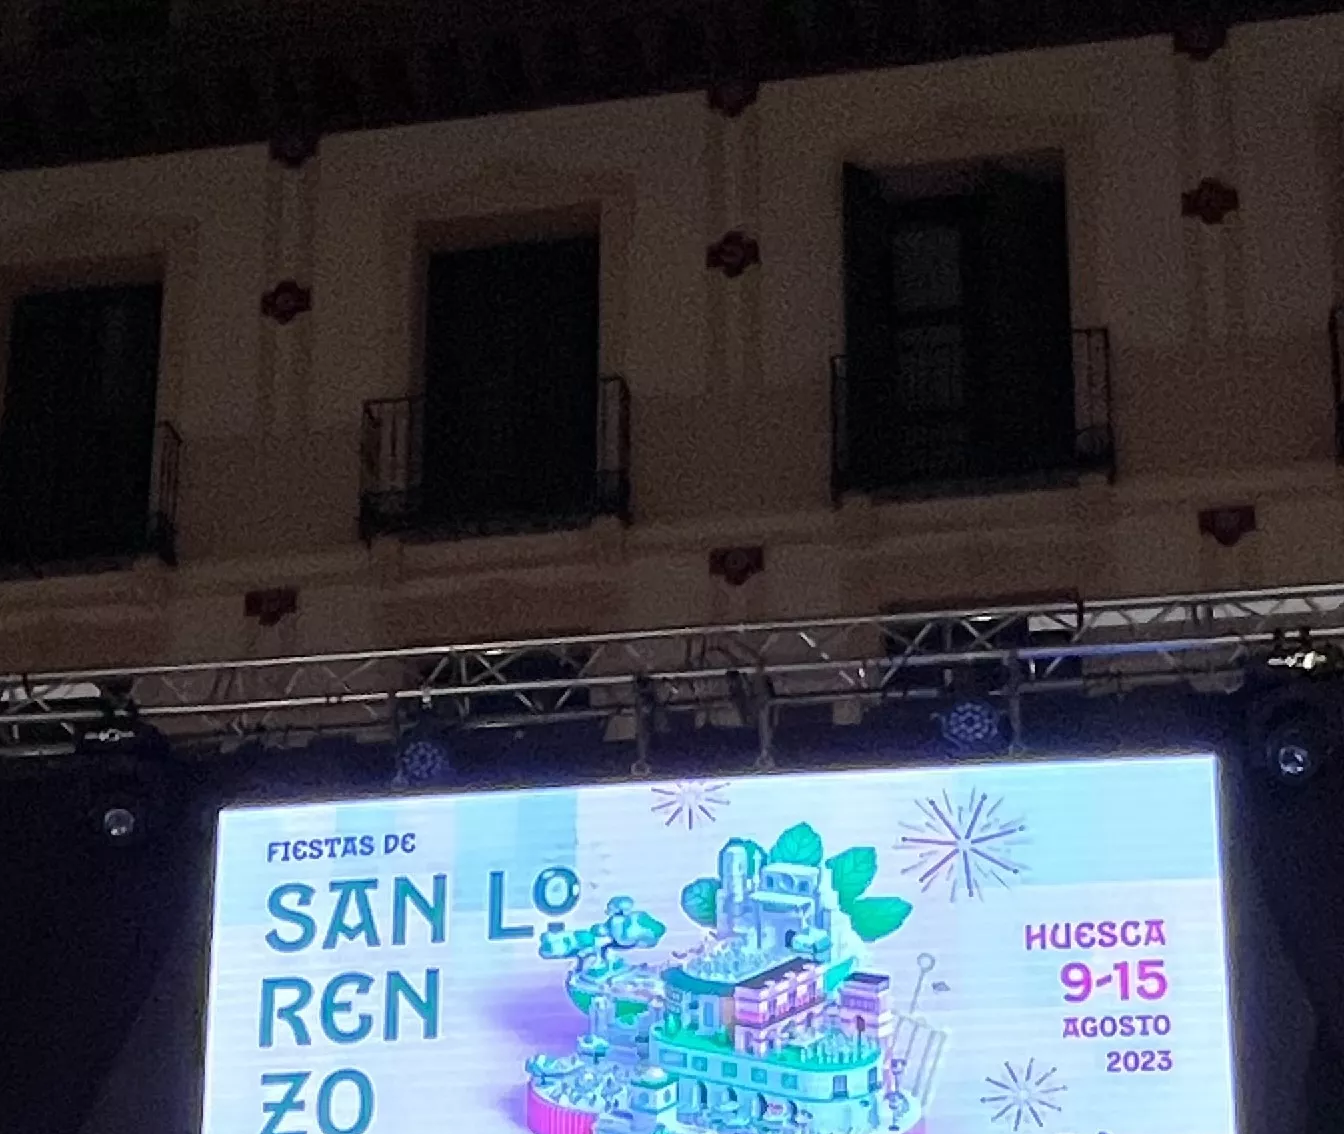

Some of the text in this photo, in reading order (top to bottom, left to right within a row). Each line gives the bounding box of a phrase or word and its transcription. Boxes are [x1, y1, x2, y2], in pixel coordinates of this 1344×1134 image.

[267, 832, 416, 862] FIESTAS DE
[265, 873, 447, 953] SAN
[1025, 919, 1166, 950] HUESCA
[1060, 959, 1168, 1003] 9-15
[258, 967, 439, 1047] REN
[1062, 1014, 1171, 1038] AGOSTO
[1106, 1050, 1173, 1072] 2023
